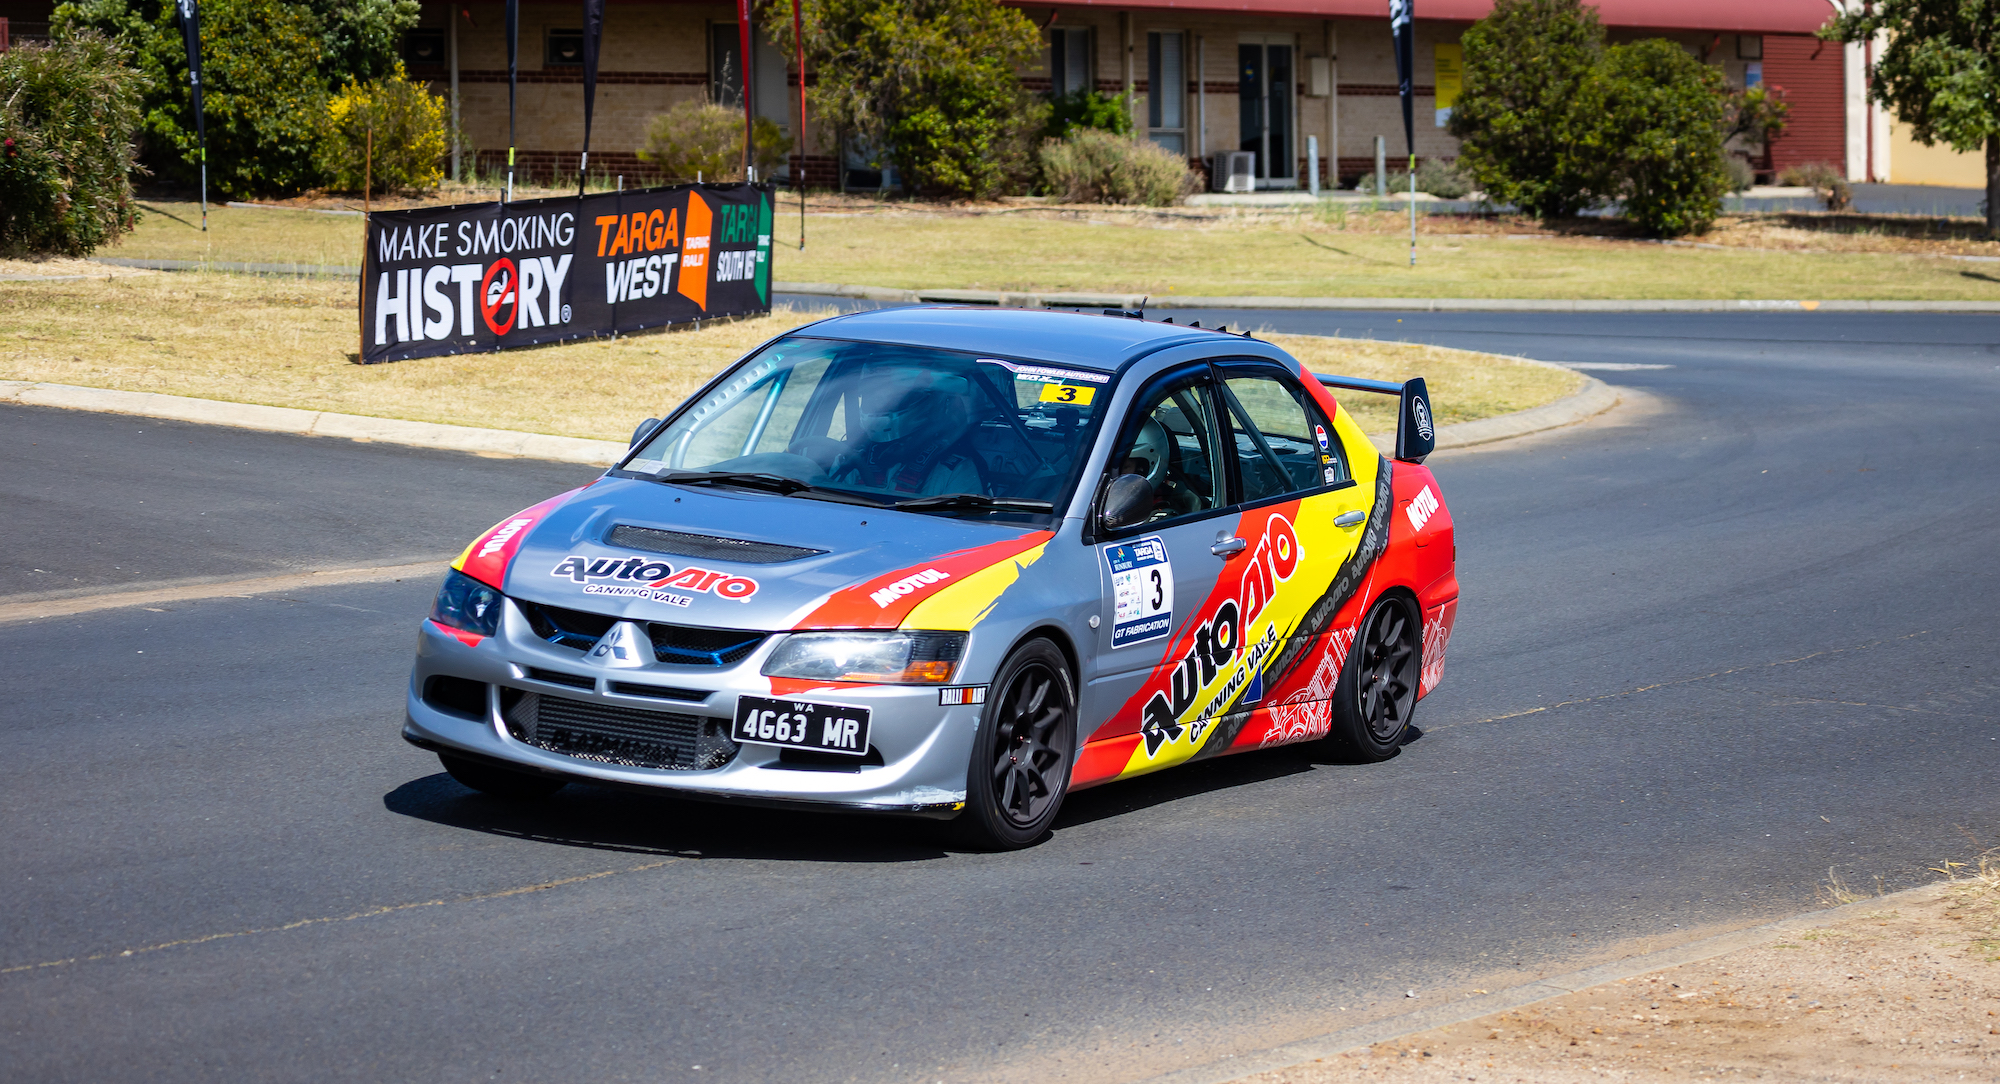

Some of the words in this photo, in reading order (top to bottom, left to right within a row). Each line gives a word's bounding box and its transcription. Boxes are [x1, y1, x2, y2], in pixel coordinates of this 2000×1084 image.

[379, 223, 449, 262] MAKE
[457, 211, 575, 257] SMOKING
[594, 207, 679, 257] TARGA
[605, 252, 678, 304] WEST
[1056, 387, 1078, 402] 3
[1406, 484, 1440, 532] MOTUL
[477, 519, 533, 557] MOTUL
[584, 584, 649, 598] CANNING
[653, 591, 691, 607] VALE
[869, 568, 951, 609] MOTUL
[1150, 569, 1163, 610] 3
[1115, 629, 1126, 639] GT
[1125, 618, 1169, 637] FABRICATION
[1191, 667, 1245, 742] CANNING
[1248, 625, 1275, 672] VALE
[793, 702, 814, 713] WA
[742, 709, 807, 743] 4G63
[821, 717, 859, 749] MR
